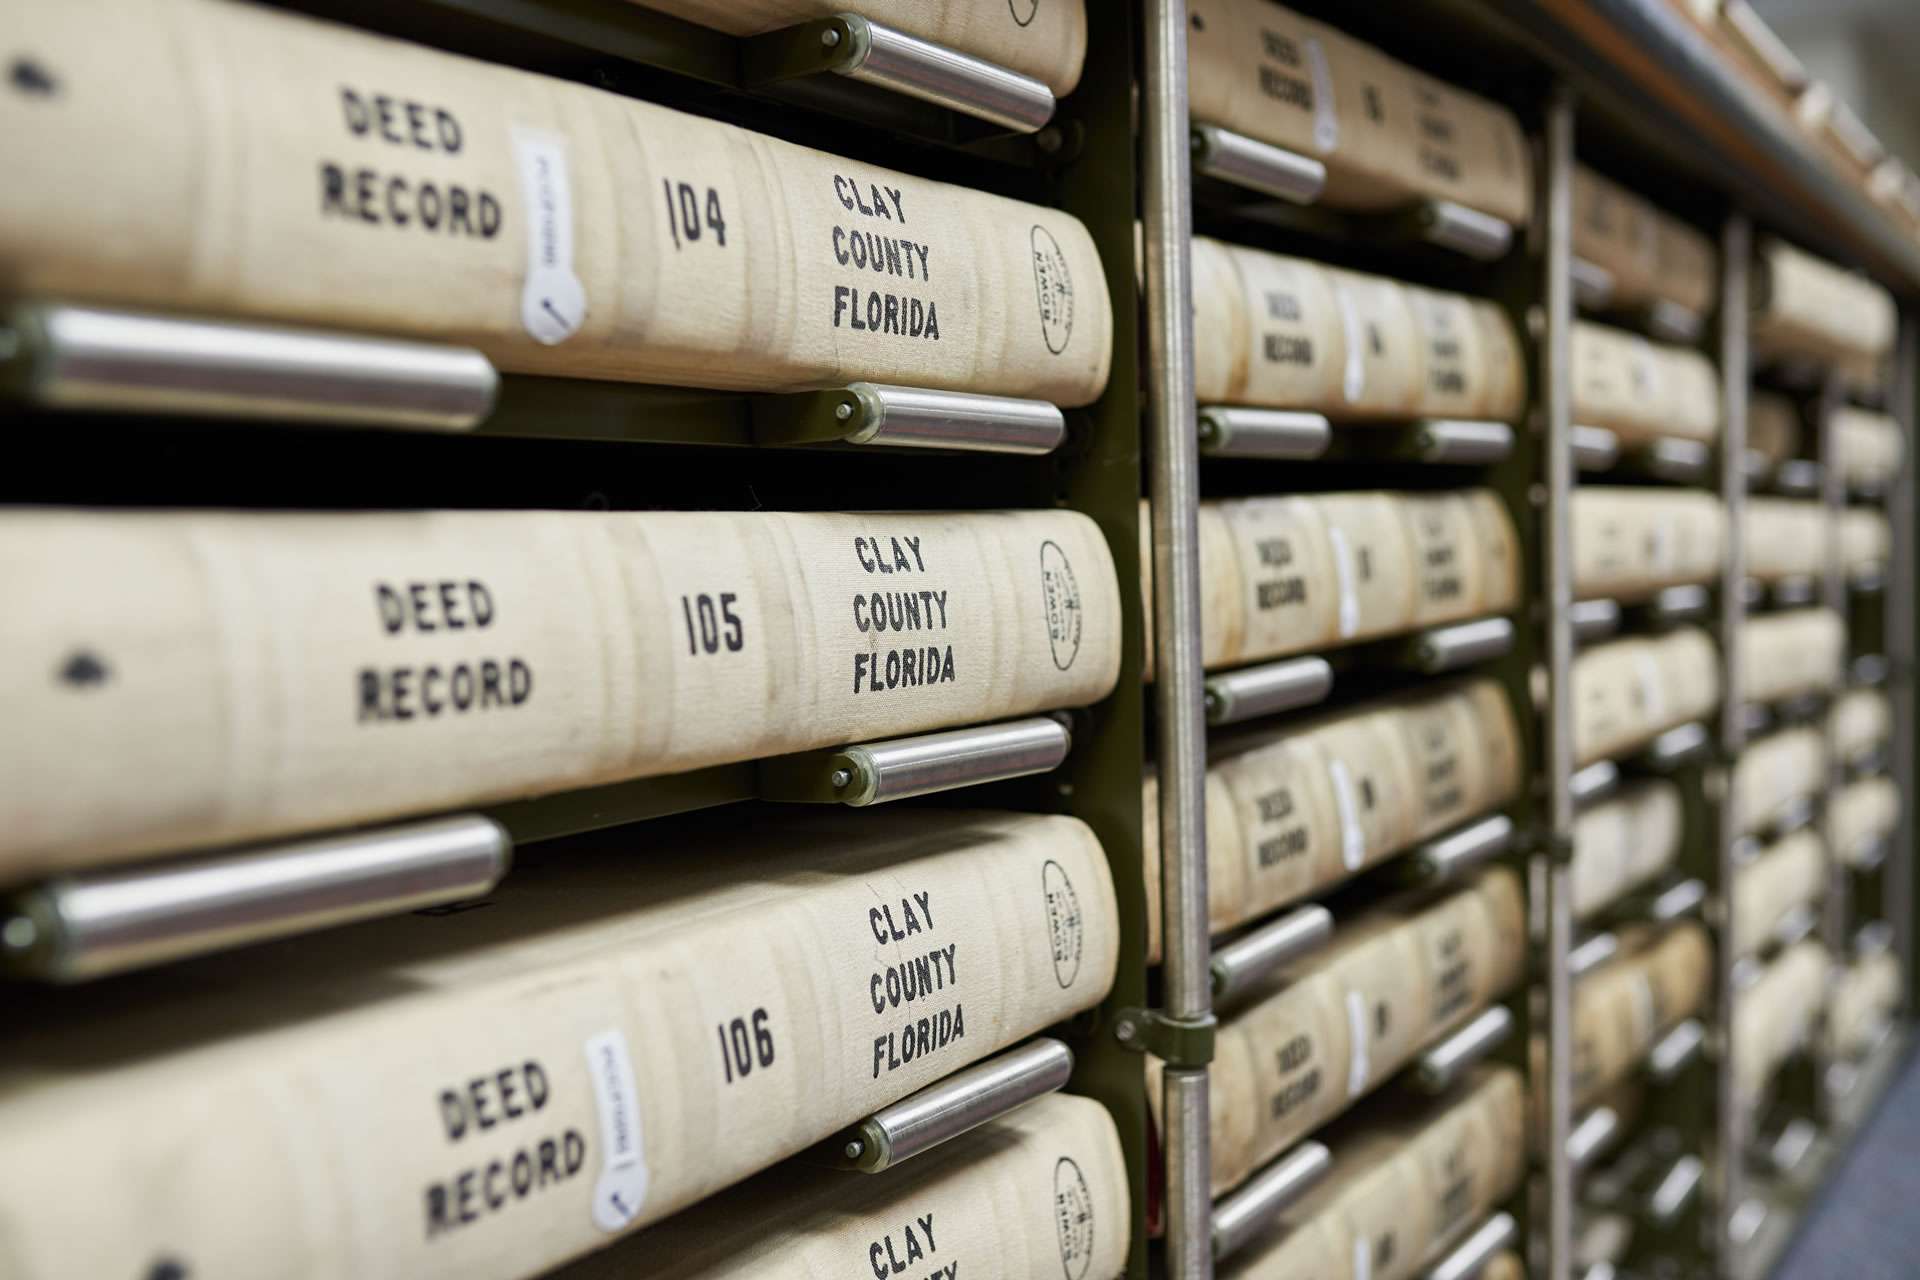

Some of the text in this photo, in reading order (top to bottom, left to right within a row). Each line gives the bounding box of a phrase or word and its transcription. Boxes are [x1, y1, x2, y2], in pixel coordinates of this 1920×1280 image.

[340, 86, 463, 154] DEED
[320, 163, 502, 239] RECORD
[663, 178, 726, 250] 104
[833, 173, 906, 224] CLAY
[832, 225, 930, 282] COUNTY
[833, 285, 940, 341] FLORIDA
[854, 535, 925, 574] CLAY
[374, 579, 495, 636] DEED
[682, 592, 744, 656] 105
[853, 589, 947, 633] COUNTY
[357, 658, 534, 725] RECORD
[853, 645, 956, 694] FLORIDA
[868, 890, 935, 946] CLAY
[869, 943, 957, 1015] COUNTY
[718, 1007, 775, 1084] 106
[872, 1004, 965, 1079] FLORIDA
[438, 1061, 549, 1142] DEED
[424, 1129, 586, 1239] RECORD
[869, 1213, 936, 1280] CLAY
